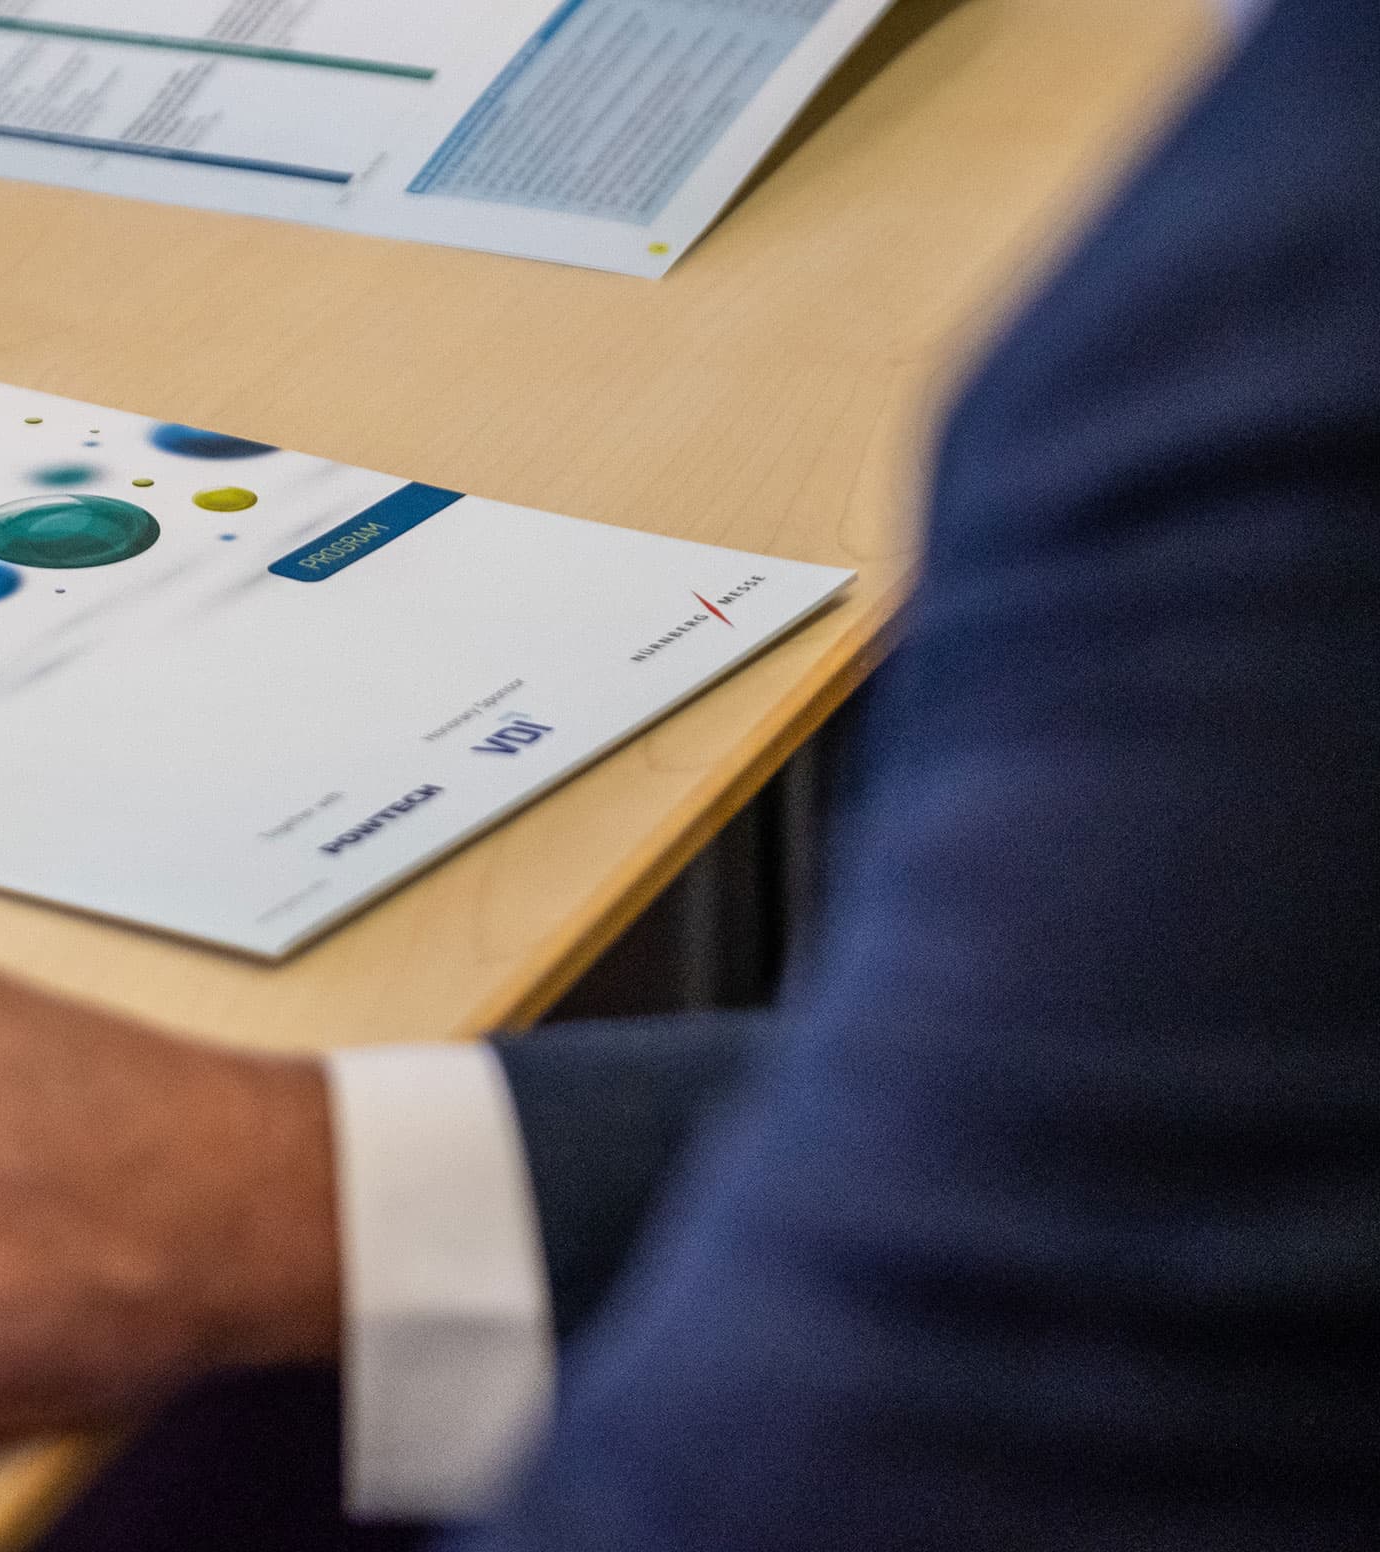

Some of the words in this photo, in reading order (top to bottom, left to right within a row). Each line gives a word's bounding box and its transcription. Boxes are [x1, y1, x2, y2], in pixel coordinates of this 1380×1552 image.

[298, 522, 390, 571] PROGRAM
[717, 575, 766, 605] MESSE
[469, 718, 554, 754] VDI
[318, 783, 445, 854] POWTECH
